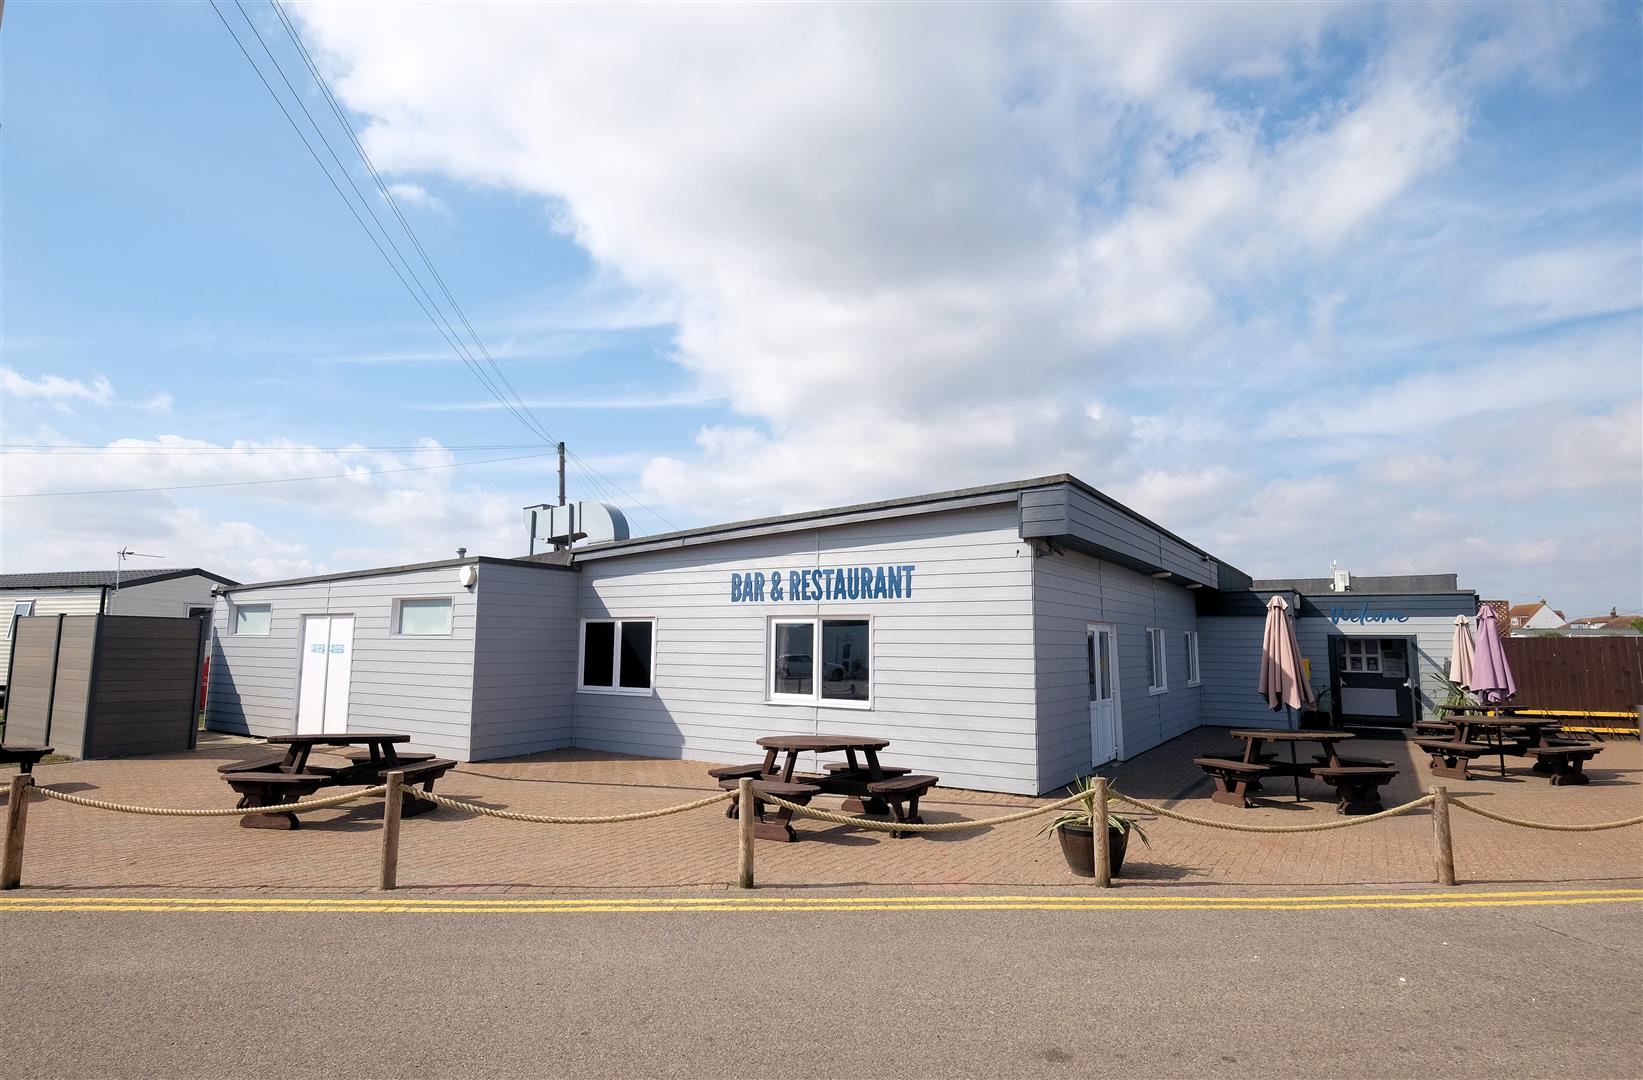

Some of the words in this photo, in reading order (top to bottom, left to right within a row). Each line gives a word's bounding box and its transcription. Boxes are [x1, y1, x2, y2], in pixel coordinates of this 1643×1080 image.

[731, 572, 765, 602] BAR
[770, 571, 784, 602] &
[789, 565, 915, 601] RESTAURANT
[1329, 601, 1410, 625] Welcome
